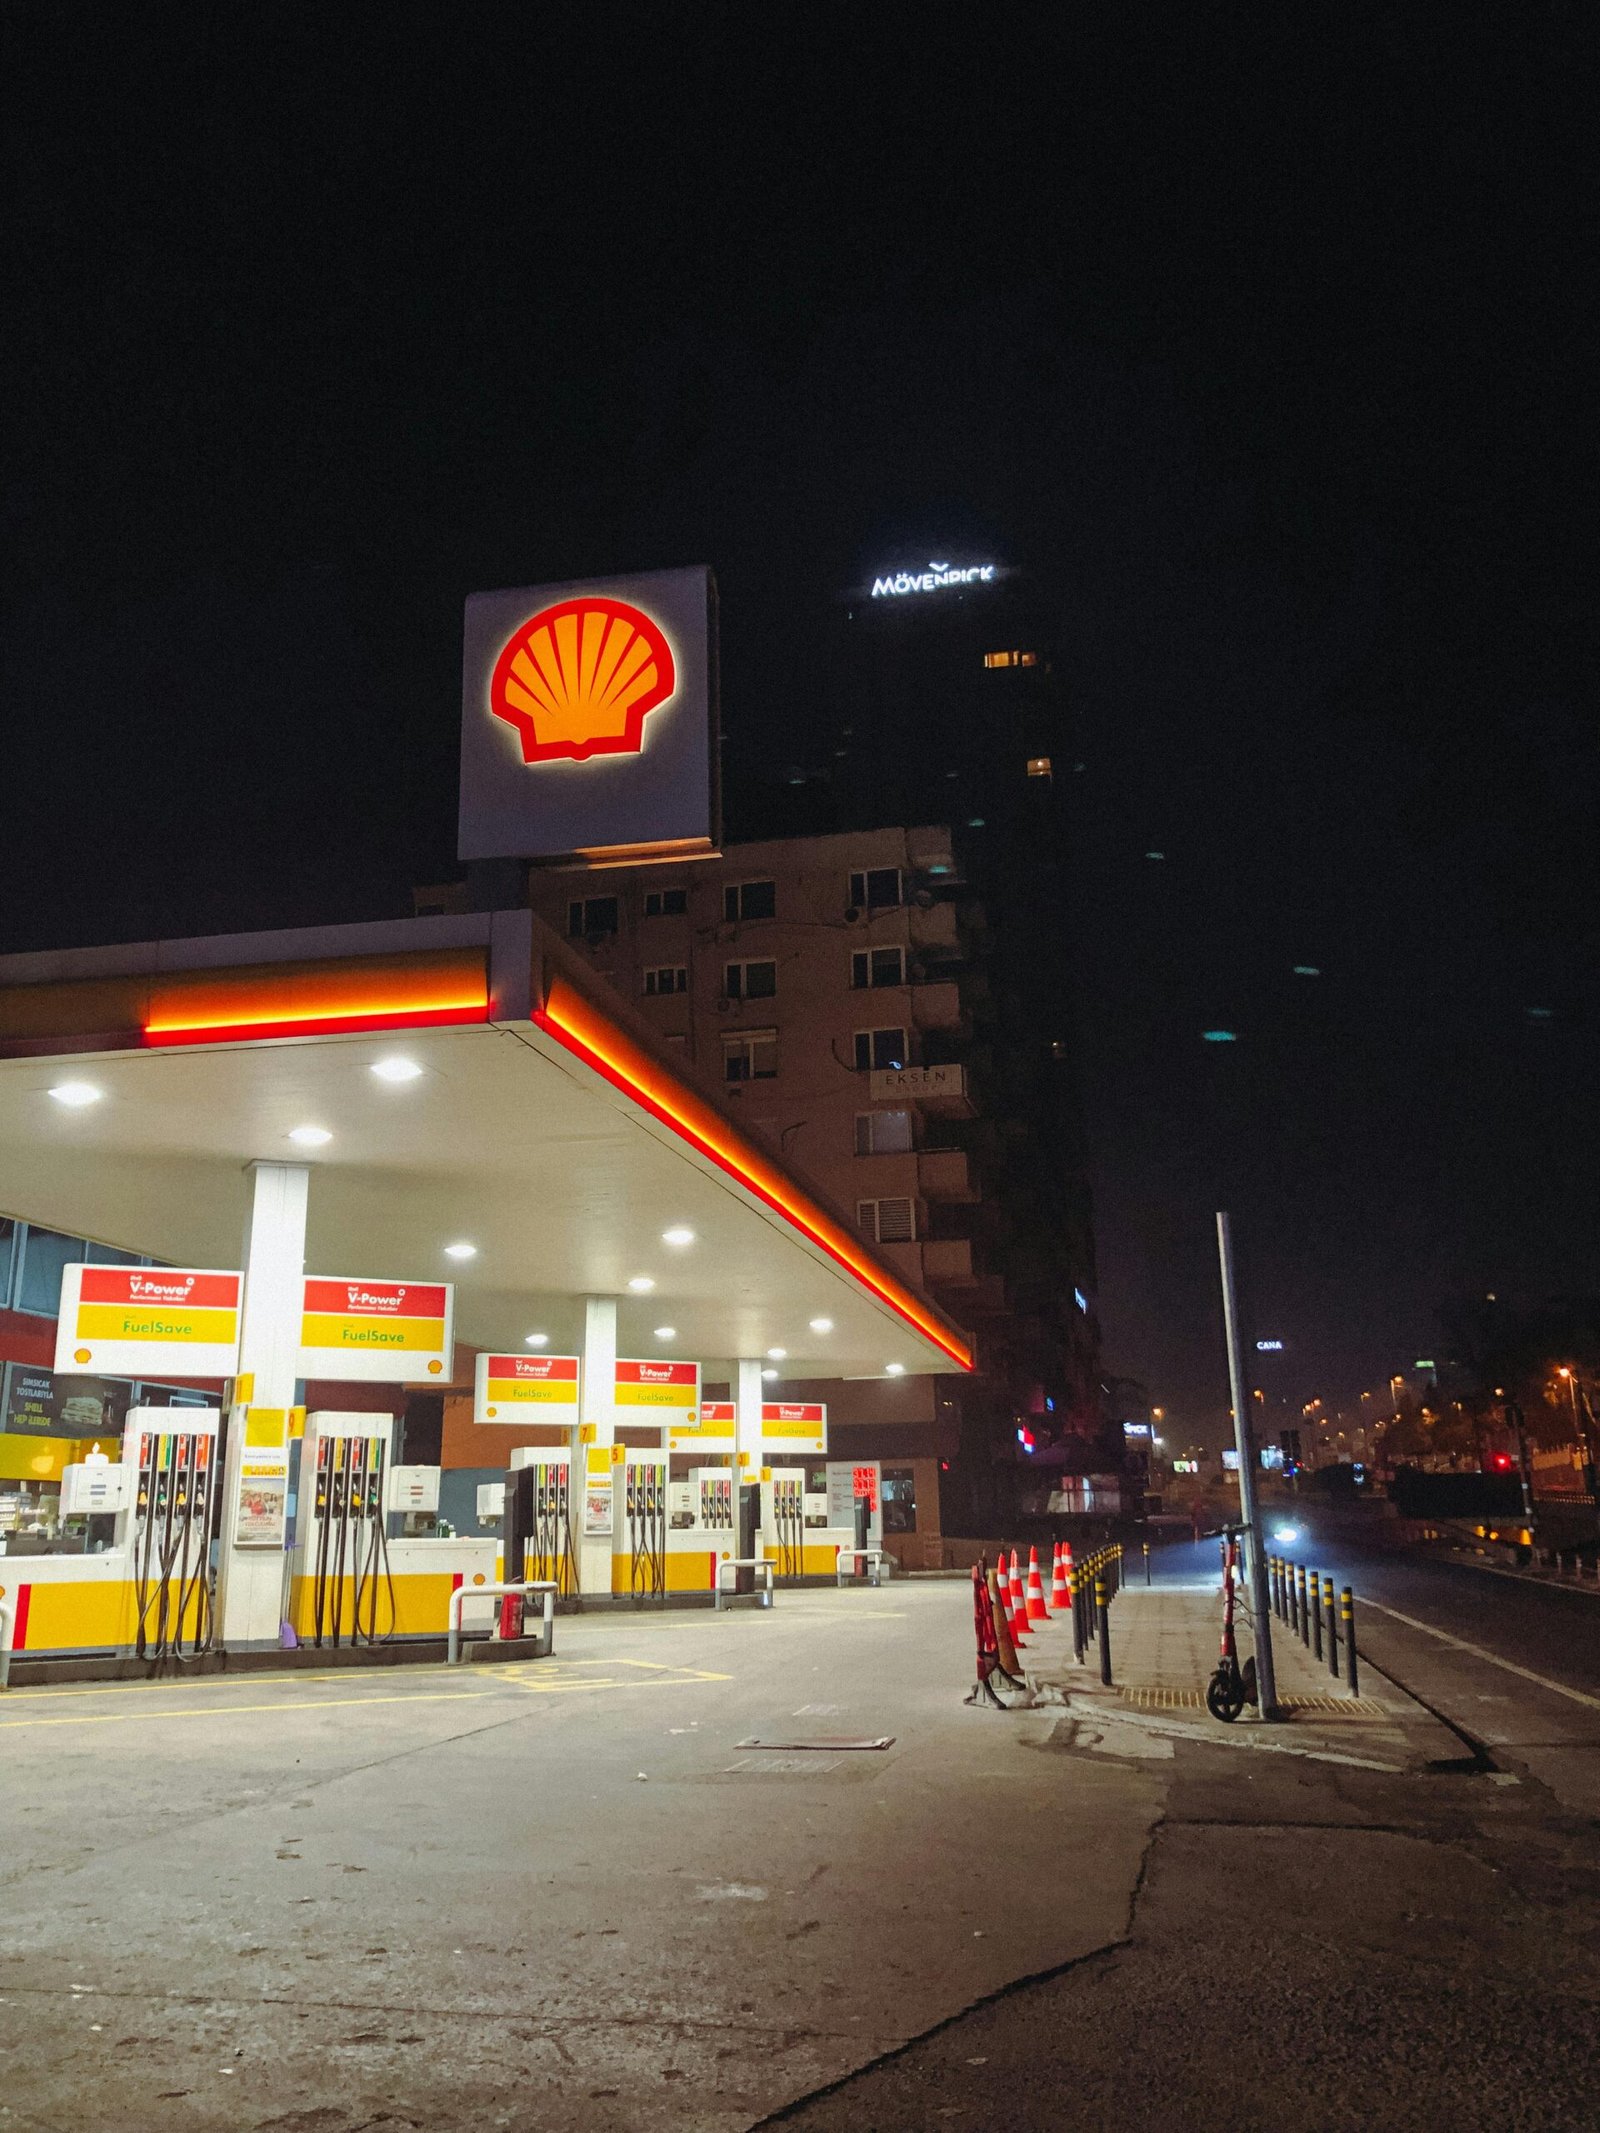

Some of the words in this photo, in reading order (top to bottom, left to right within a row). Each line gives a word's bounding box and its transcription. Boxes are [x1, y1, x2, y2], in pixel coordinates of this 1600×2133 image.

[871, 564, 994, 596] MÖVENPICK
[886, 1071, 946, 1085] EKSEN
[129, 1281, 192, 1296] V-Power
[348, 1292, 403, 1306] V-Power
[123, 1320, 192, 1335] FuelSave
[342, 1329, 405, 1343] FuelSave
[516, 1364, 550, 1373] V-Power
[639, 1368, 672, 1378] V-Power
[513, 1388, 552, 1398] FuelSave
[637, 1392, 674, 1401] FuelSave
[288, 1412, 295, 1433] 9
[582, 1427, 588, 1441] 7
[612, 1448, 618, 1461] 5
